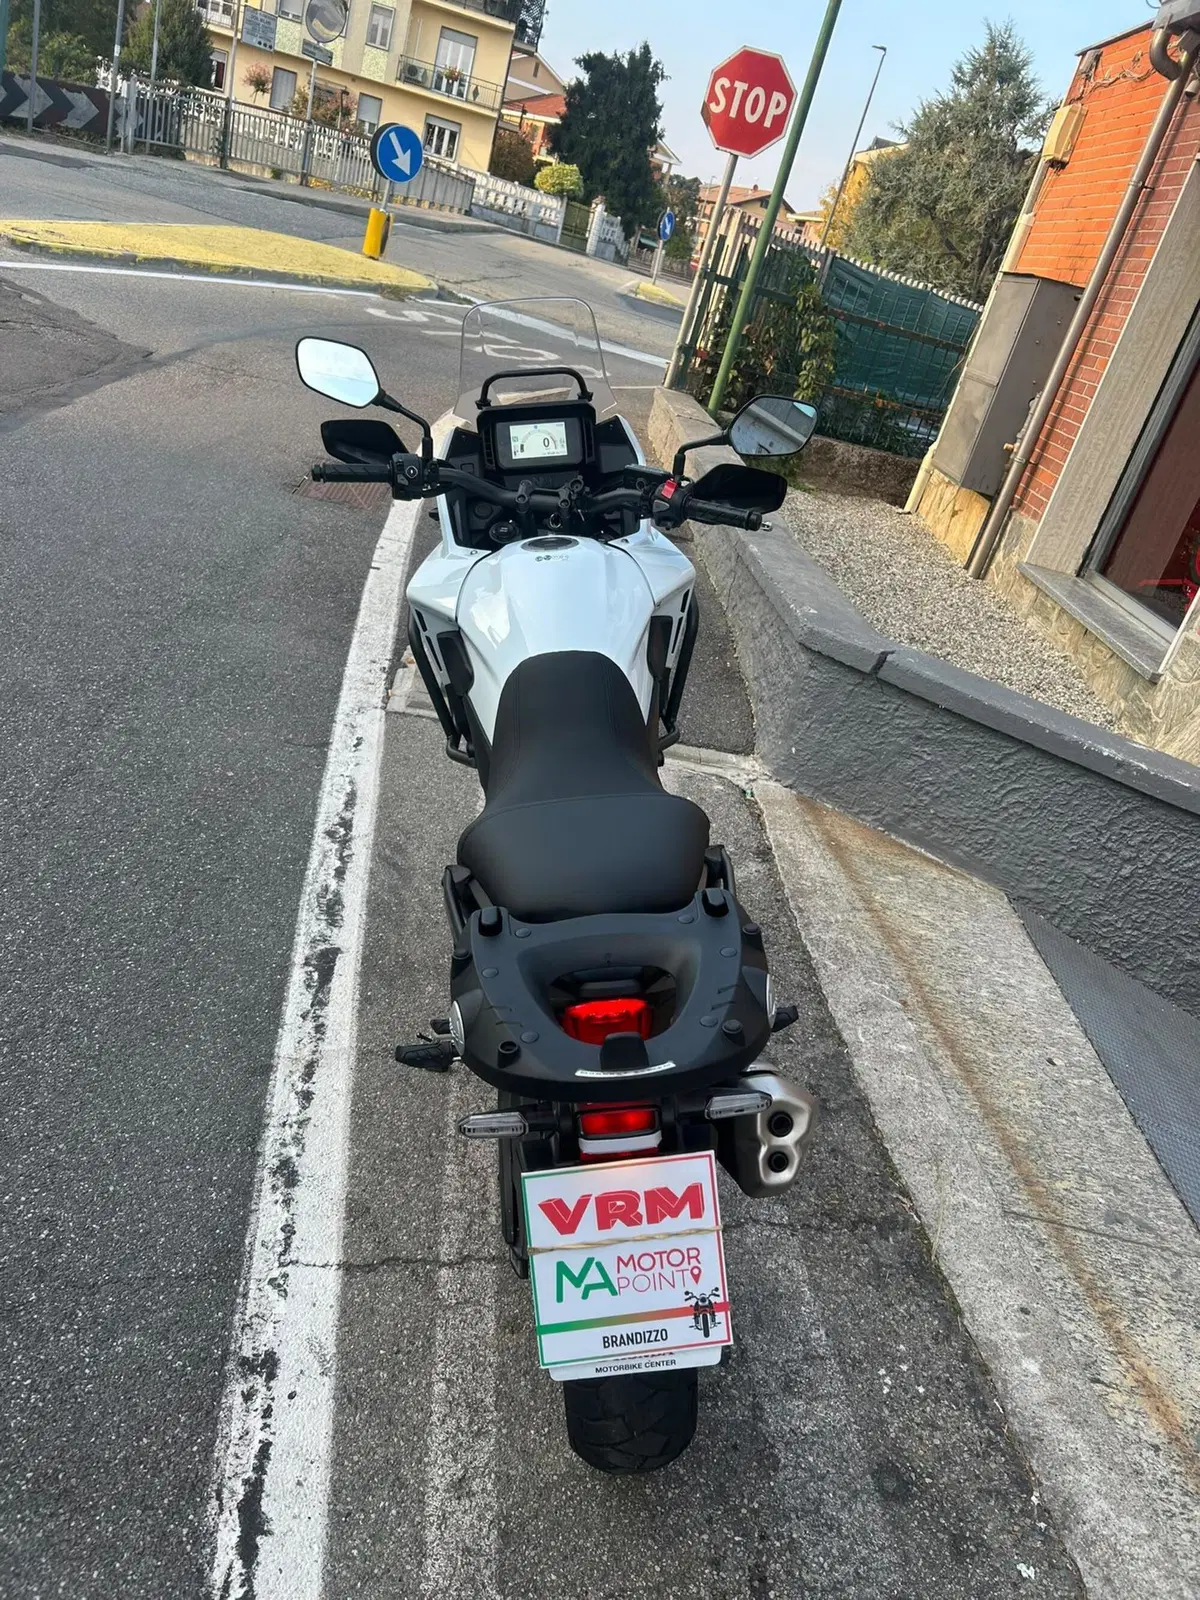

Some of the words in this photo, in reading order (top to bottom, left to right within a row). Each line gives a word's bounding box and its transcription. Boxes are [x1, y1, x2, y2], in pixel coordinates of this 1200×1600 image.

[709, 76, 787, 128] STOP
[542, 437, 550, 448] 0
[538, 1182, 705, 1236] VRM
[616, 1247, 701, 1274] MOTOR
[617, 1267, 690, 1296] POINT
[602, 1328, 668, 1349] BRANDIZZO
[595, 1362, 643, 1374] MOTORBIKE
[644, 1358, 677, 1369] CENTER
